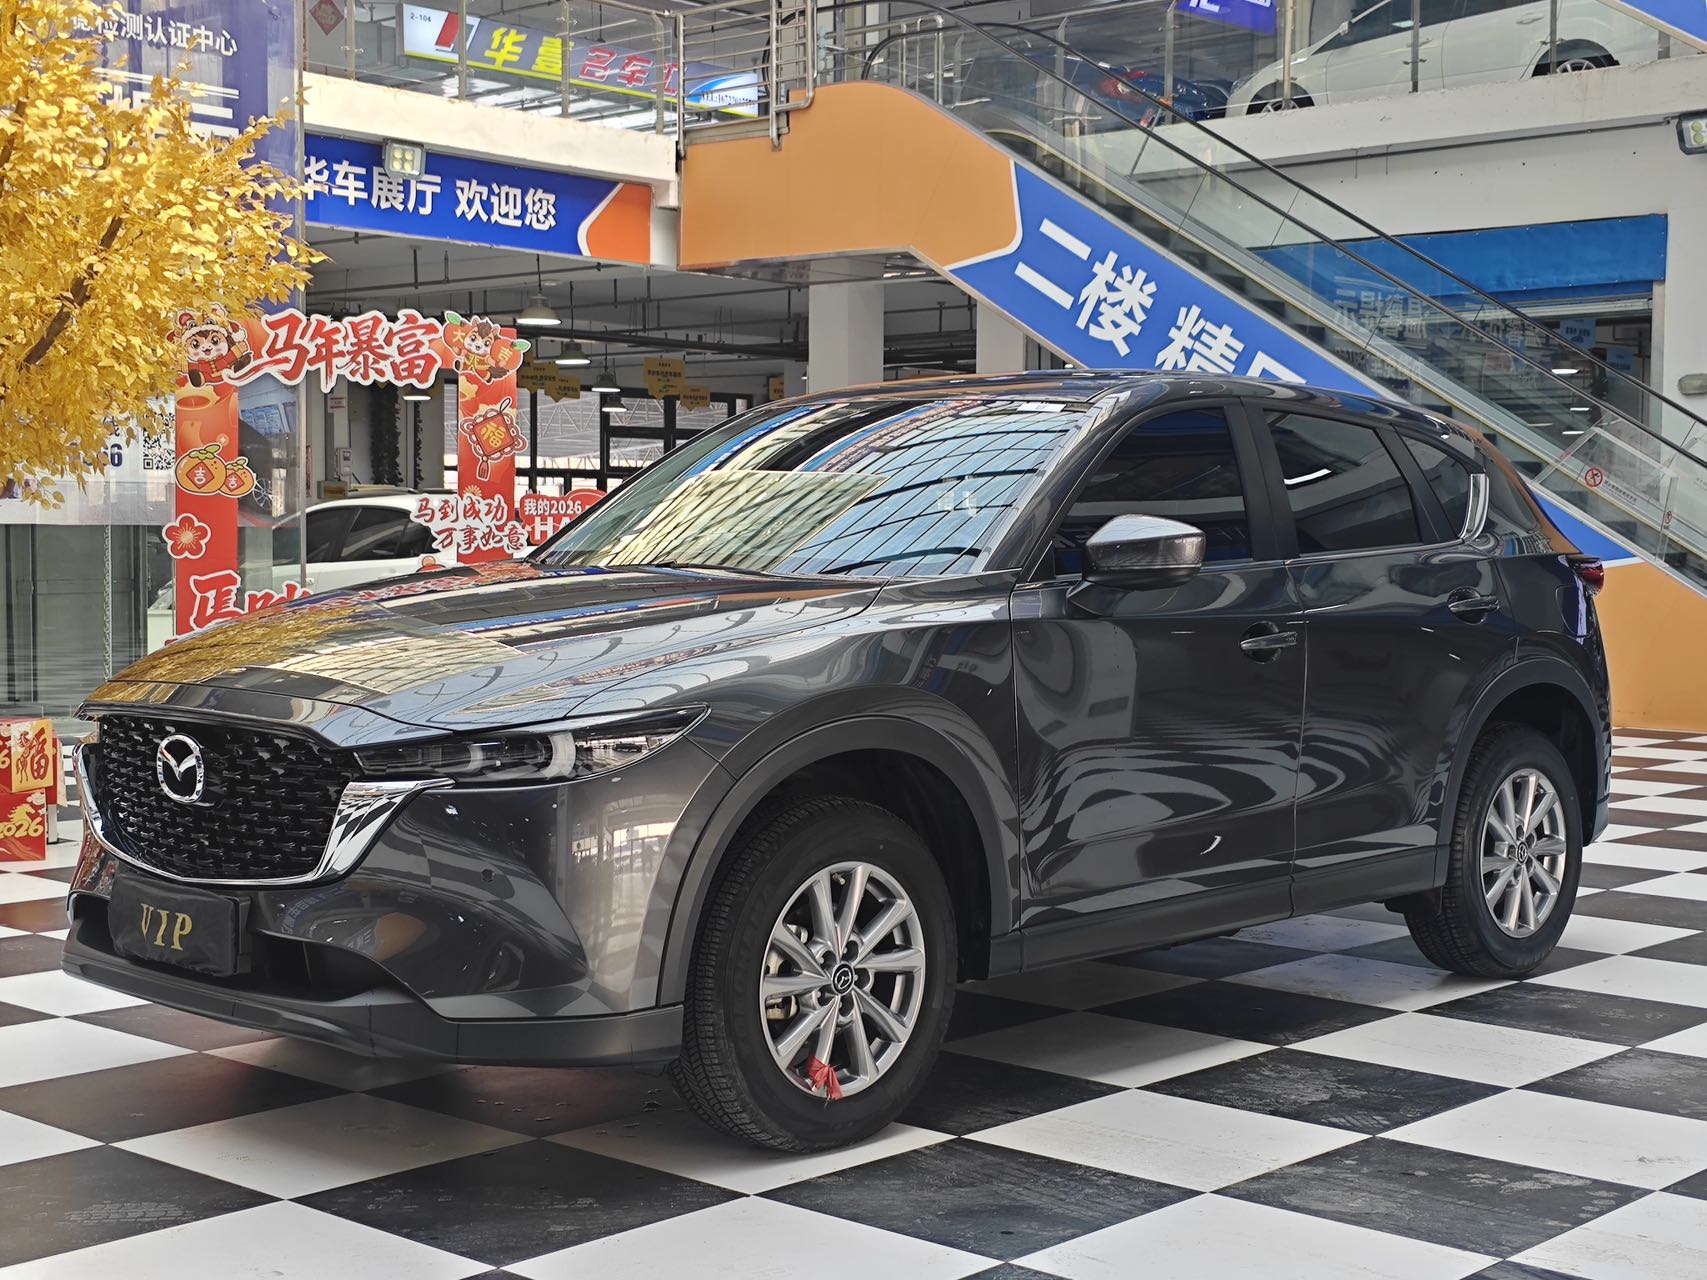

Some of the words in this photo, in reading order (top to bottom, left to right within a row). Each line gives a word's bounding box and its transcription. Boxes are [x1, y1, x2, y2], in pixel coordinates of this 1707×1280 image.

[454, 178, 557, 231] 欢迎您
[1014, 217, 1158, 358] 二楼
[1154, 304, 1307, 384] 精
[227, 312, 440, 390] 马年暴富
[480, 421, 507, 449] 福
[194, 467, 208, 485] 吉
[228, 475, 239, 489] 吉
[414, 496, 507, 524] 马到成功
[524, 498, 582, 516] 我的2026
[434, 524, 524, 551] 万事如意
[141, 903, 193, 951] VIP
